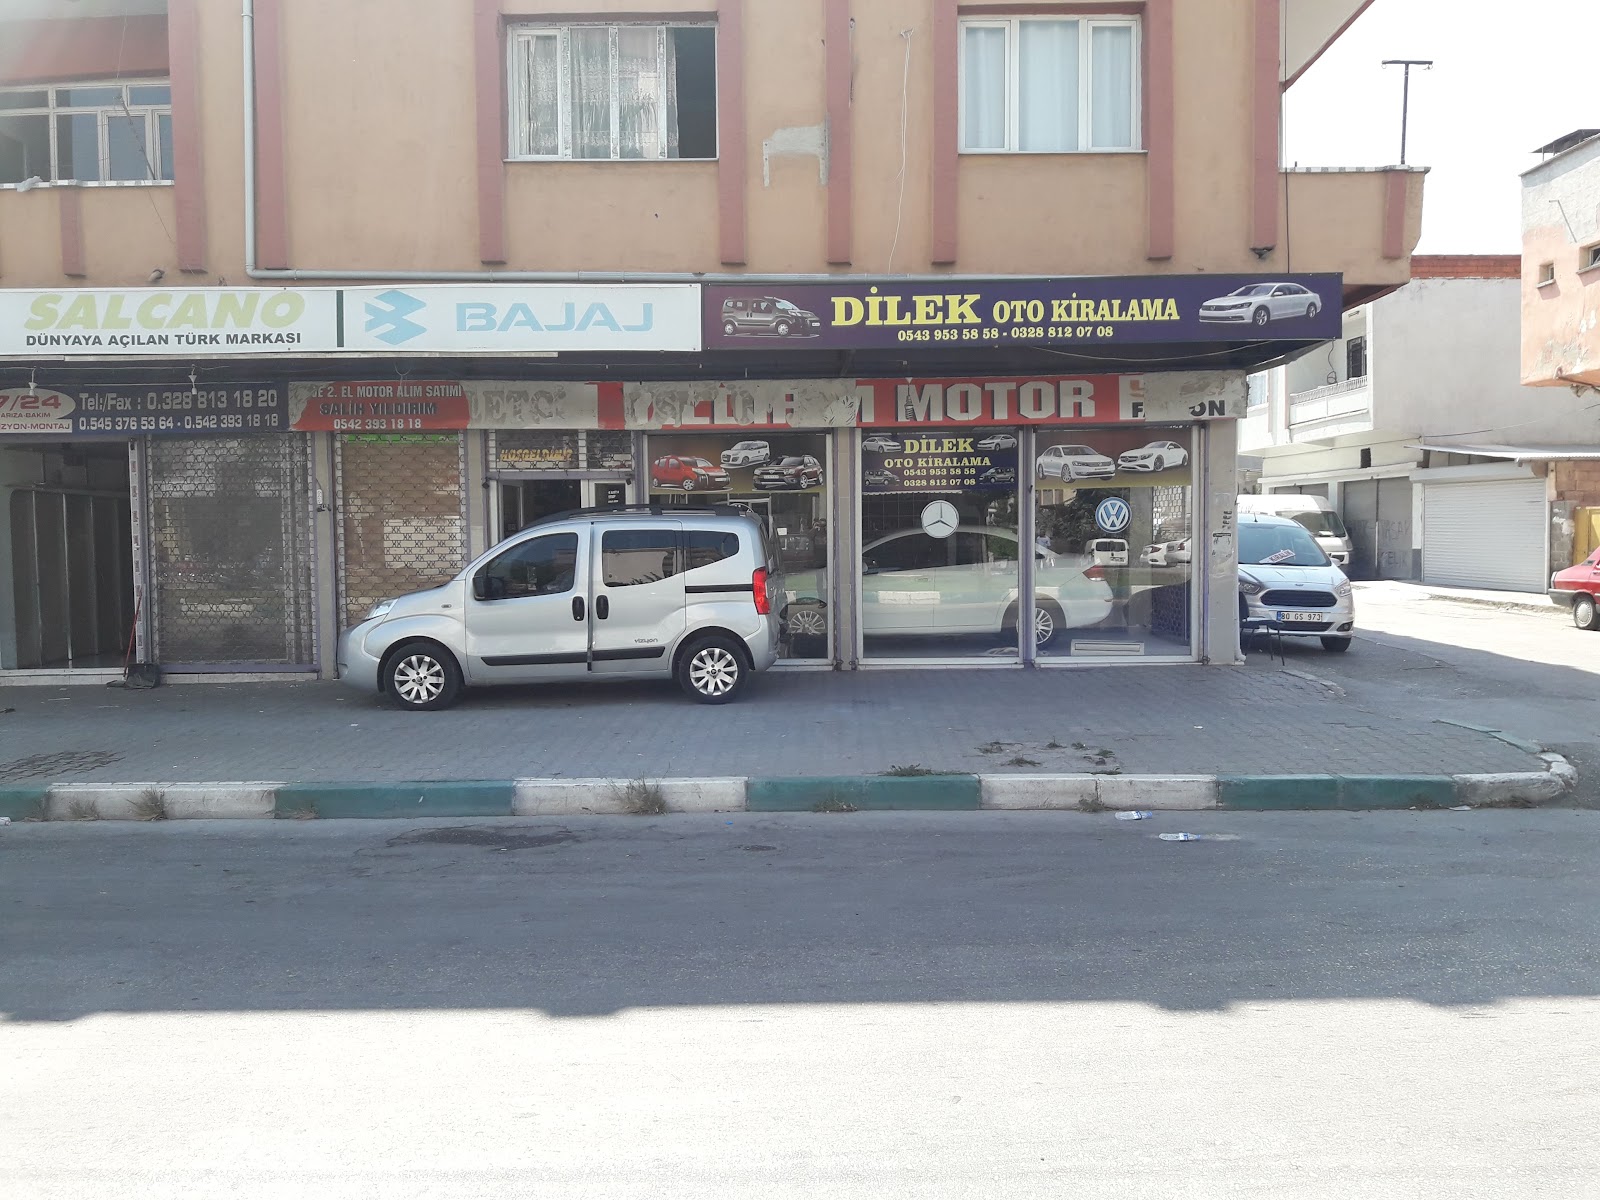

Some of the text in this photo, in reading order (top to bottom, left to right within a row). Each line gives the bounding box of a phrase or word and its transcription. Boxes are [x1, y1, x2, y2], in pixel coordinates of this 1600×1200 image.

[23, 291, 306, 330] SALCANO
[831, 286, 1180, 326] DİLEK OTO KİRALAMA
[456, 302, 653, 332] BAJAJ
[26, 332, 302, 348] DÜNYAYA AÇILAN TÜRK MARKASI
[898, 330, 930, 341] 0543
[934, 329, 958, 340] 953
[962, 329, 979, 340] 58
[982, 328, 999, 339] 58
[1011, 327, 1044, 338] 0328
[1048, 326, 1073, 337] 812
[1076, 326, 1093, 337] 07
[1097, 326, 1114, 337] 08
[147, 392, 192, 410] 0.328
[197, 391, 227, 409] 813
[233, 390, 252, 408] 18
[257, 389, 277, 407] 20
[327, 386, 338, 398] 2.
[341, 386, 354, 398] EL
[356, 386, 393, 398] MOTOR
[396, 385, 423, 398] ALIM
[0, 395, 61, 411] 7/24
[896, 380, 1096, 422] MOTOR
[79, 417, 112, 431] 0.545
[115, 417, 138, 430] 376
[140, 417, 156, 430] 53
[159, 417, 174, 430] 64
[184, 415, 218, 429] 0.542
[220, 415, 242, 428] 393
[247, 414, 260, 427] 18
[264, 413, 279, 426] 18
[333, 418, 422, 430] 0542 393 18 18
[904, 435, 975, 454] DİLEK
[884, 455, 992, 468] OTO KİRALAMA
[929, 468, 947, 476] 953
[904, 479, 927, 487] 0328
[964, 478, 976, 486] 08
